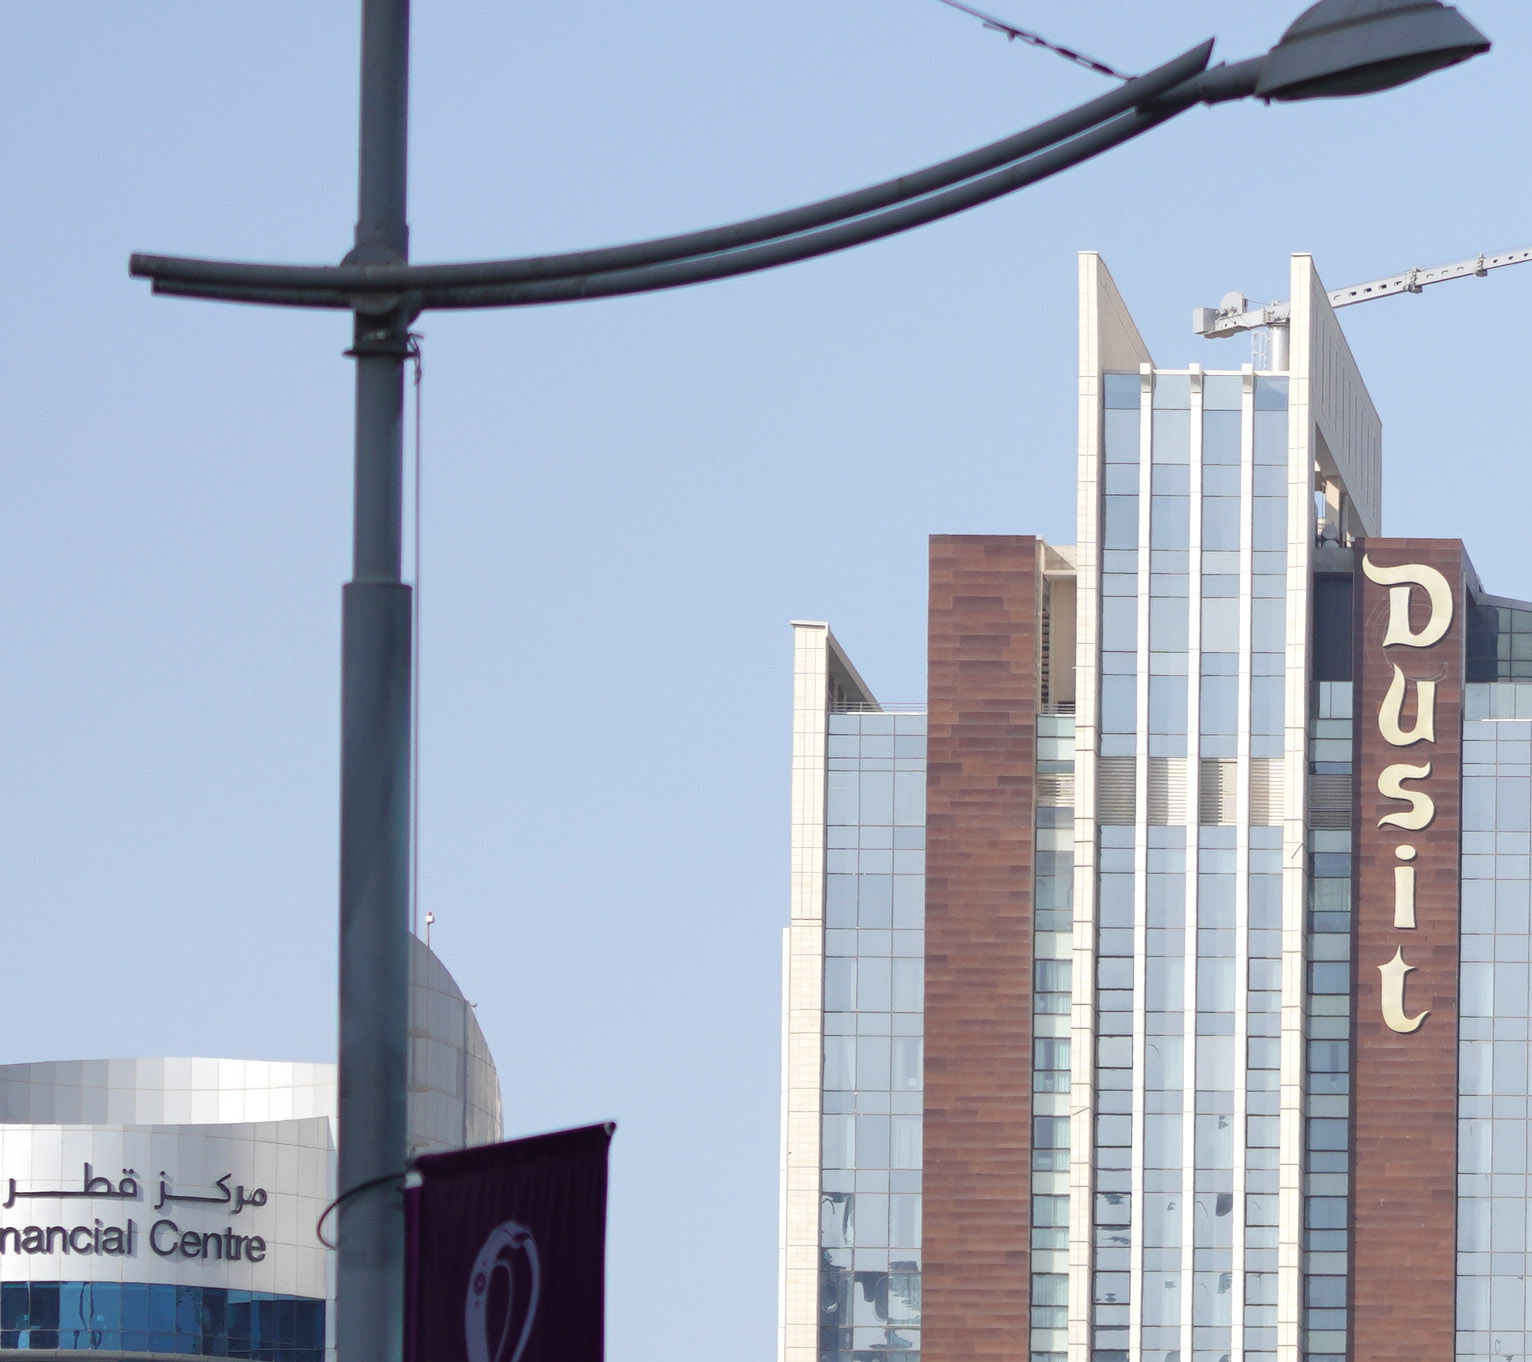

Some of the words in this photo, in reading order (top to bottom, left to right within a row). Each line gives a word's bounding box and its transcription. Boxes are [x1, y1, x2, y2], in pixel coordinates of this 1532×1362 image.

[1362, 554, 1455, 1035] Dusit
[2, 1162, 137, 1209] قطر
[154, 1171, 268, 1215] مركز
[150, 1219, 266, 1262] Centre
